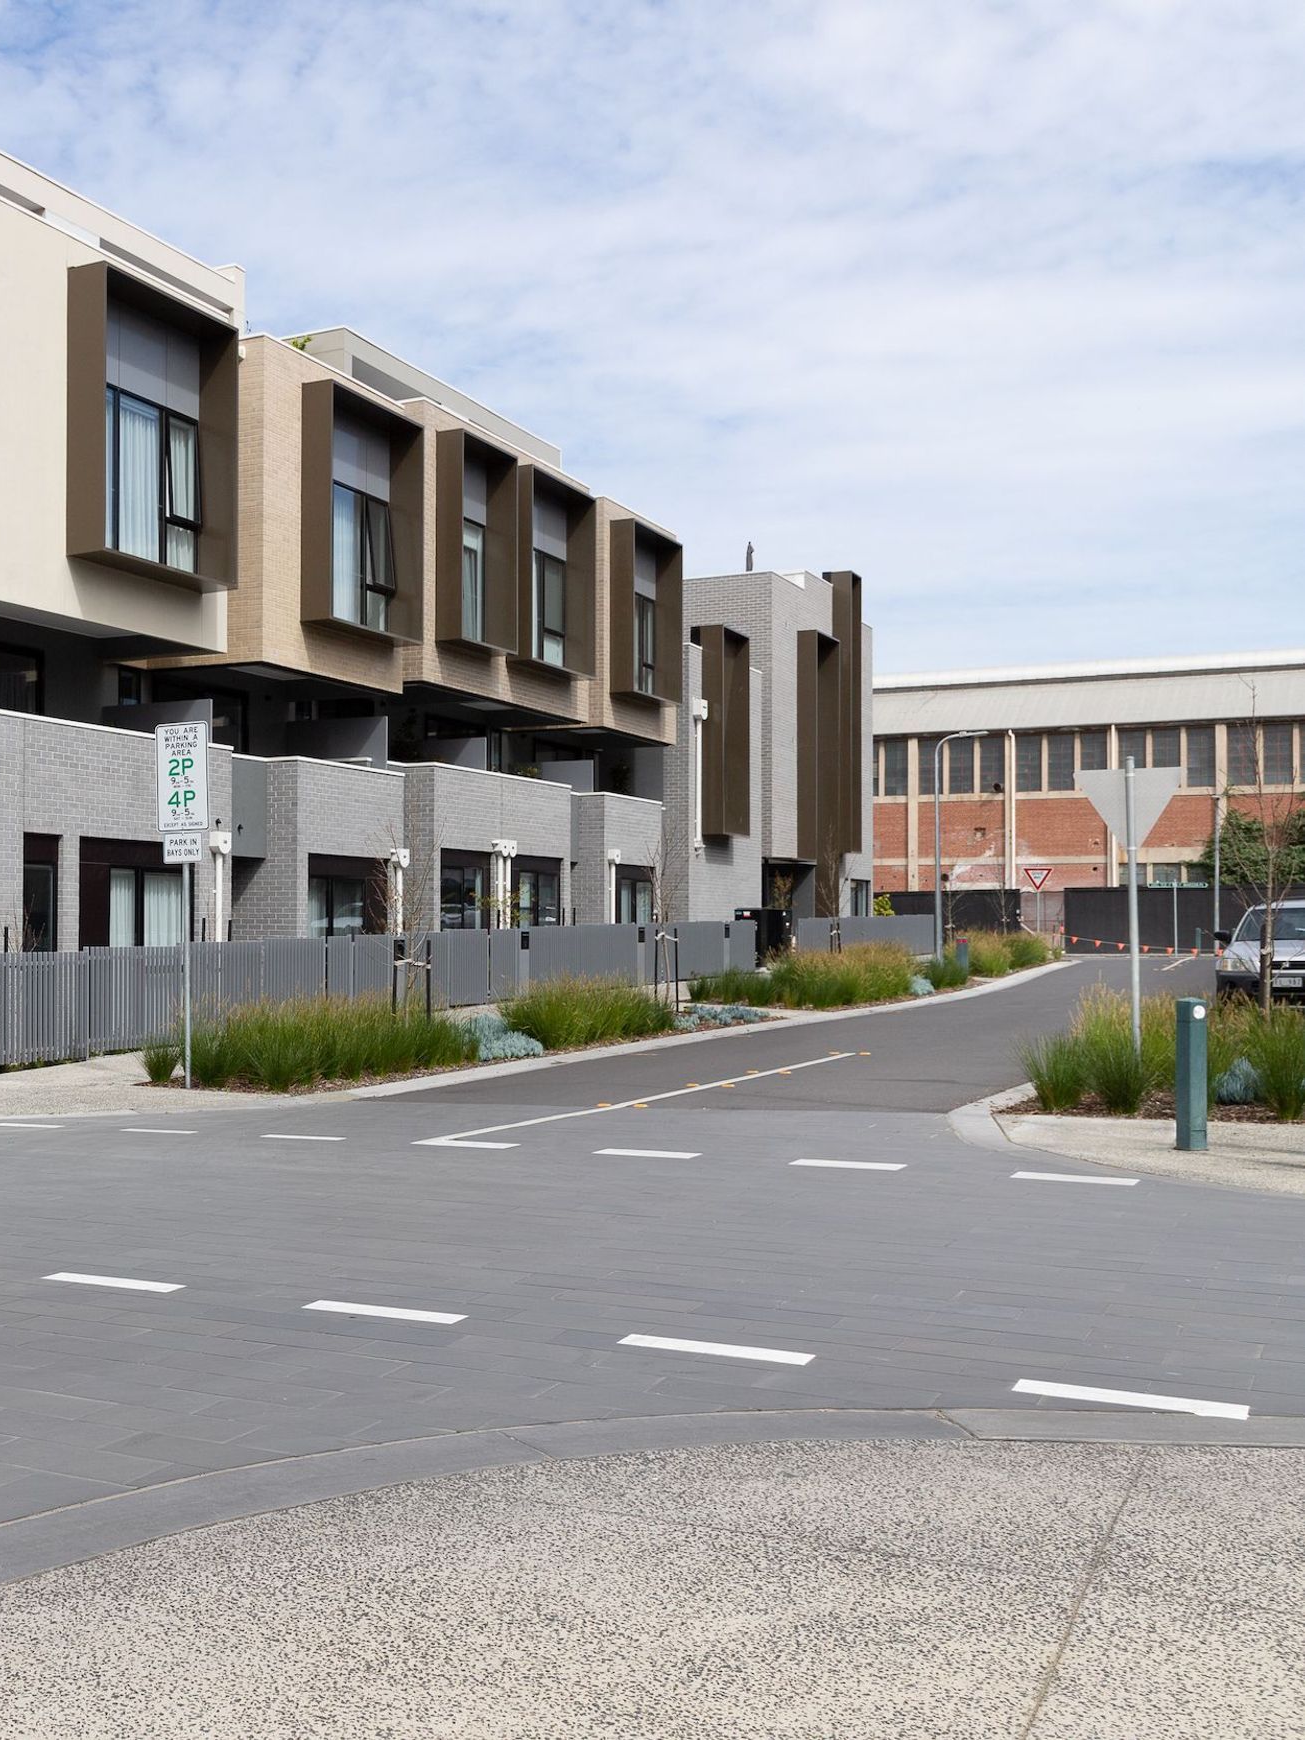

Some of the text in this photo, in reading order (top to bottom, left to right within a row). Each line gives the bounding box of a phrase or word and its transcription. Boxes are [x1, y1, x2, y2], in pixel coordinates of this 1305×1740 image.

[165, 741, 198, 749] PARKING
[168, 758, 194, 777] 2P
[167, 790, 196, 808] 4P
[167, 848, 200, 856] BAYS ONLY
